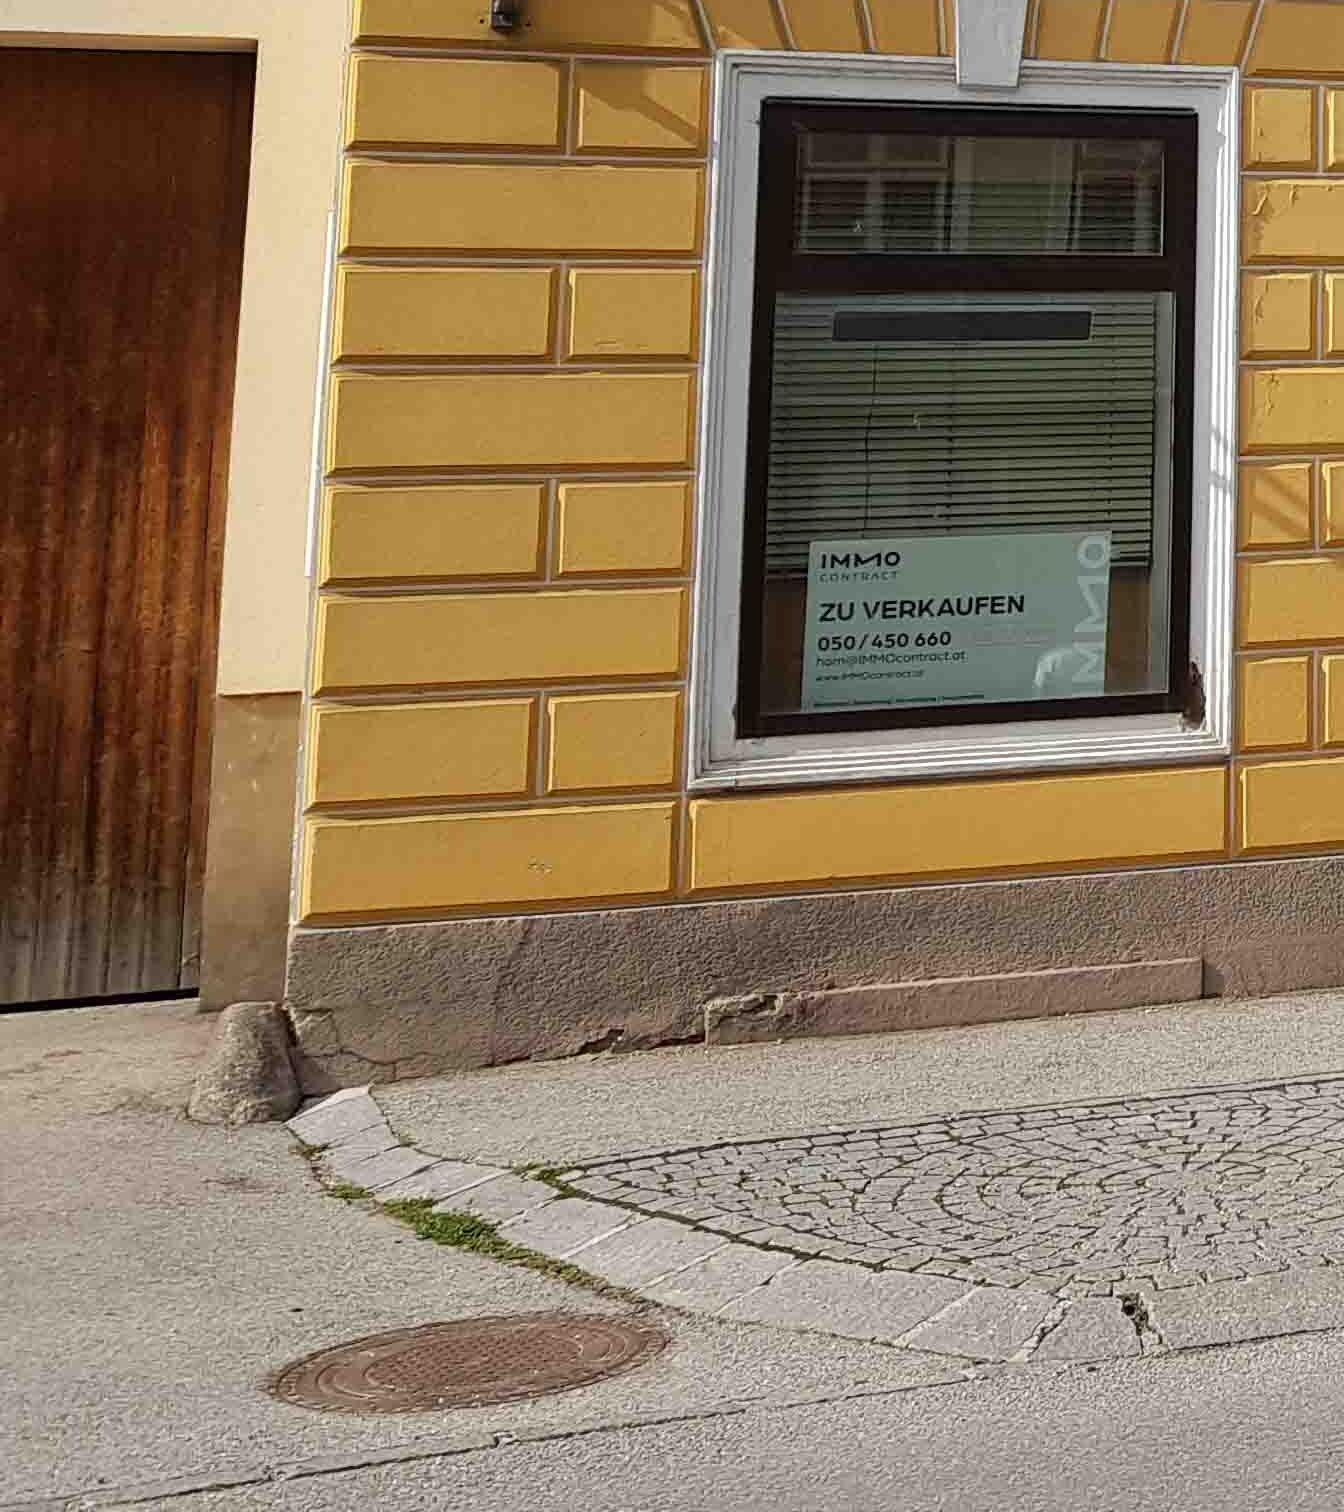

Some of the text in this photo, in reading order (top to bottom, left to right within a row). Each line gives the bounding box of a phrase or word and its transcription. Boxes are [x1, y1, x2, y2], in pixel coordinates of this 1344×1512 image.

[820, 551, 902, 570] IMMO
[819, 570, 898, 583] CONTRACT
[819, 594, 1025, 623] ZU VERKAUFEN
[914, 631, 952, 647] 660
